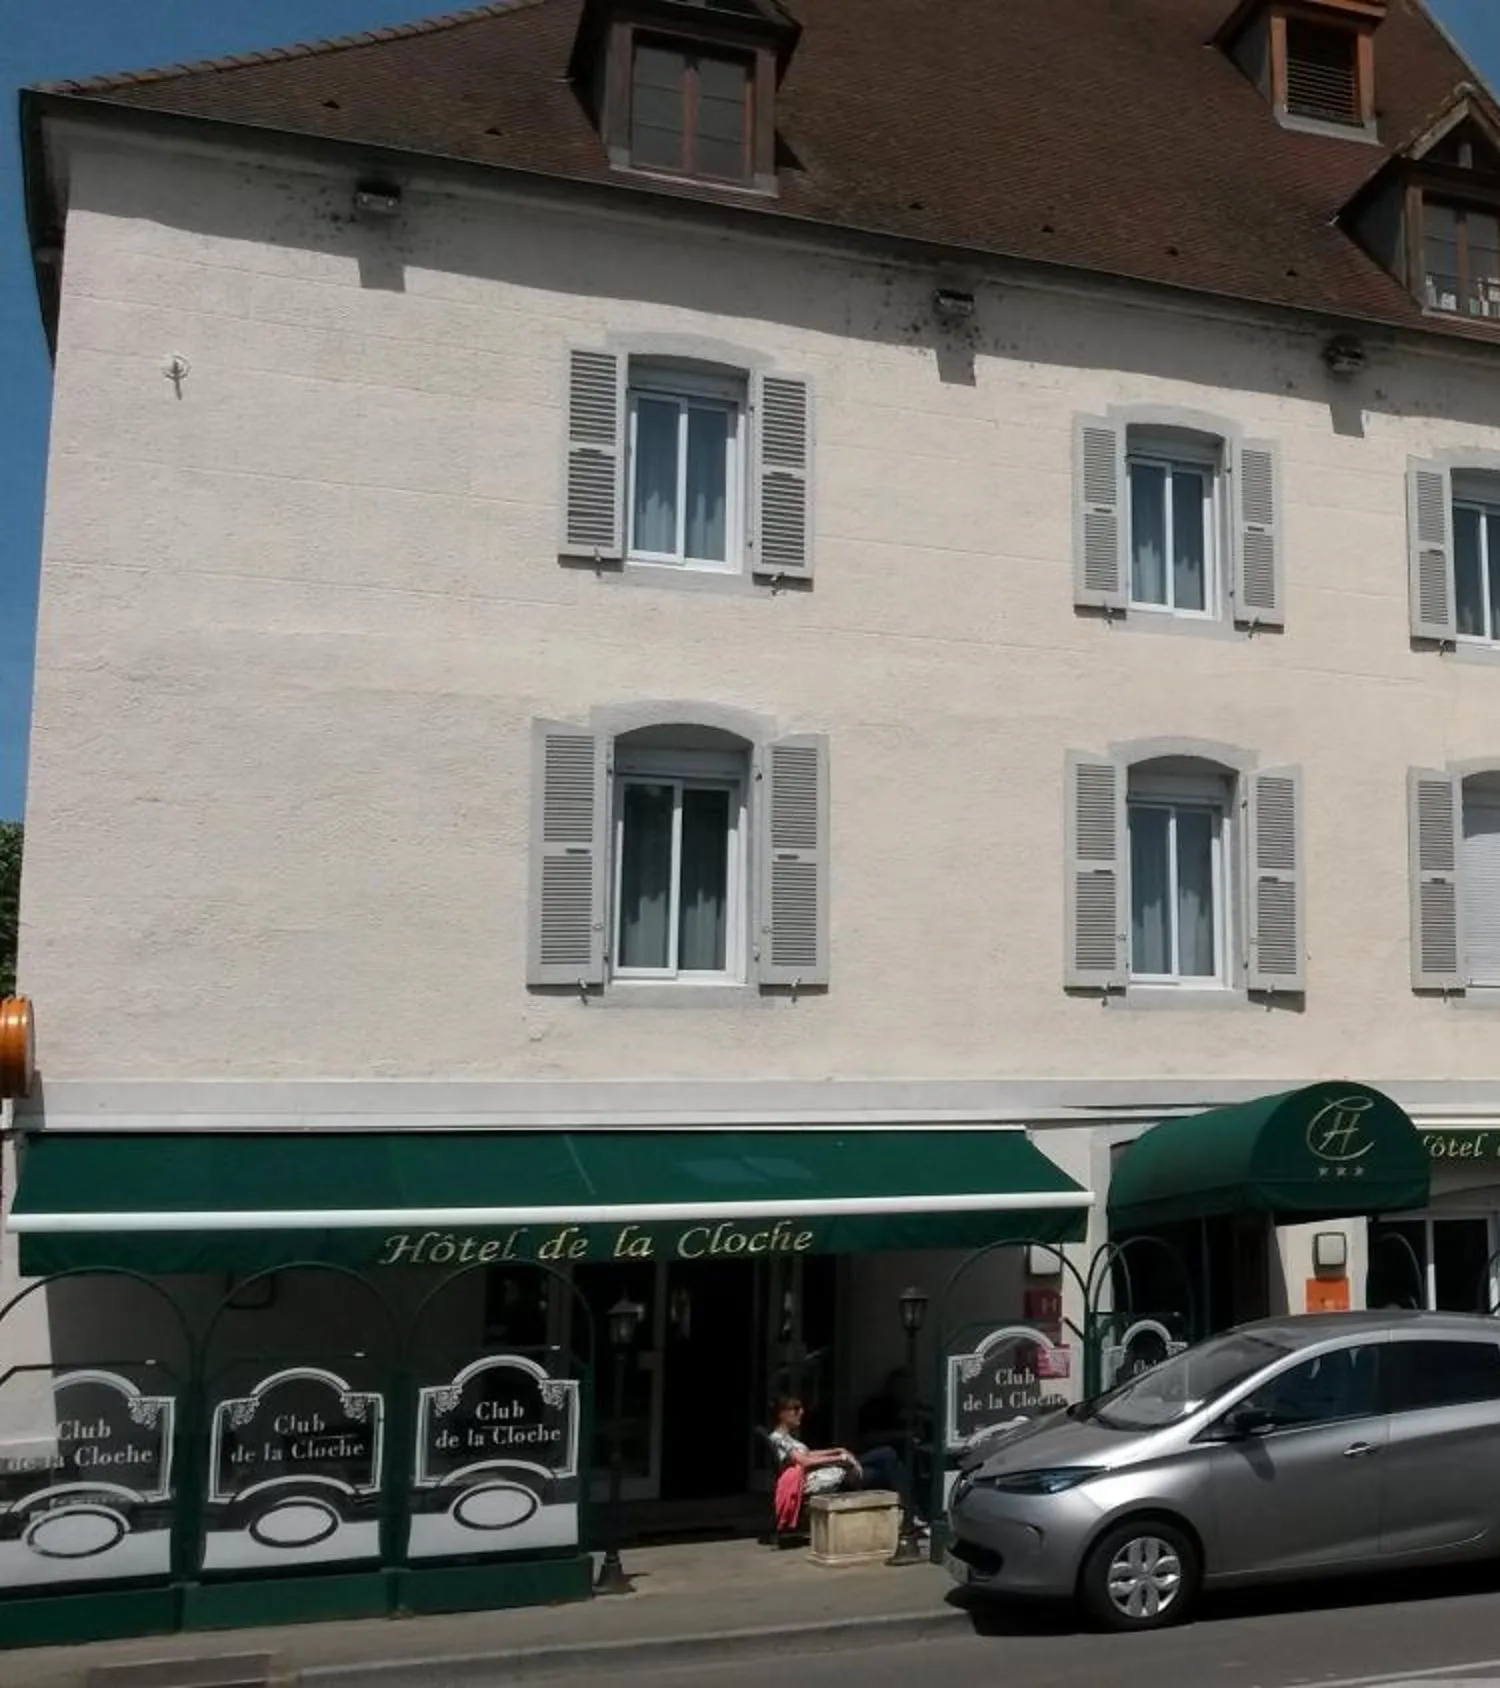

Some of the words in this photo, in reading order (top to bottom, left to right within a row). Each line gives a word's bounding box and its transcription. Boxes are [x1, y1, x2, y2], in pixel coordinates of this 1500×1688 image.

[377, 1227, 528, 1265] Hôtel
[537, 1226, 589, 1260] de
[613, 1225, 655, 1258] la
[677, 1219, 814, 1259] Cloche
[994, 1367, 1036, 1385] Club
[475, 1399, 525, 1421] Club
[963, 1393, 983, 1412] de
[989, 1392, 1004, 1409] la
[1009, 1391, 1065, 1409] Cloche
[56, 1418, 112, 1441] Club
[274, 1412, 326, 1434] Club
[435, 1429, 460, 1448] de
[468, 1428, 485, 1446] la
[493, 1423, 561, 1445] Cloche
[74, 1444, 153, 1467] Cloche
[231, 1444, 256, 1463] de
[263, 1442, 283, 1461] la
[291, 1438, 365, 1459] Cloche
